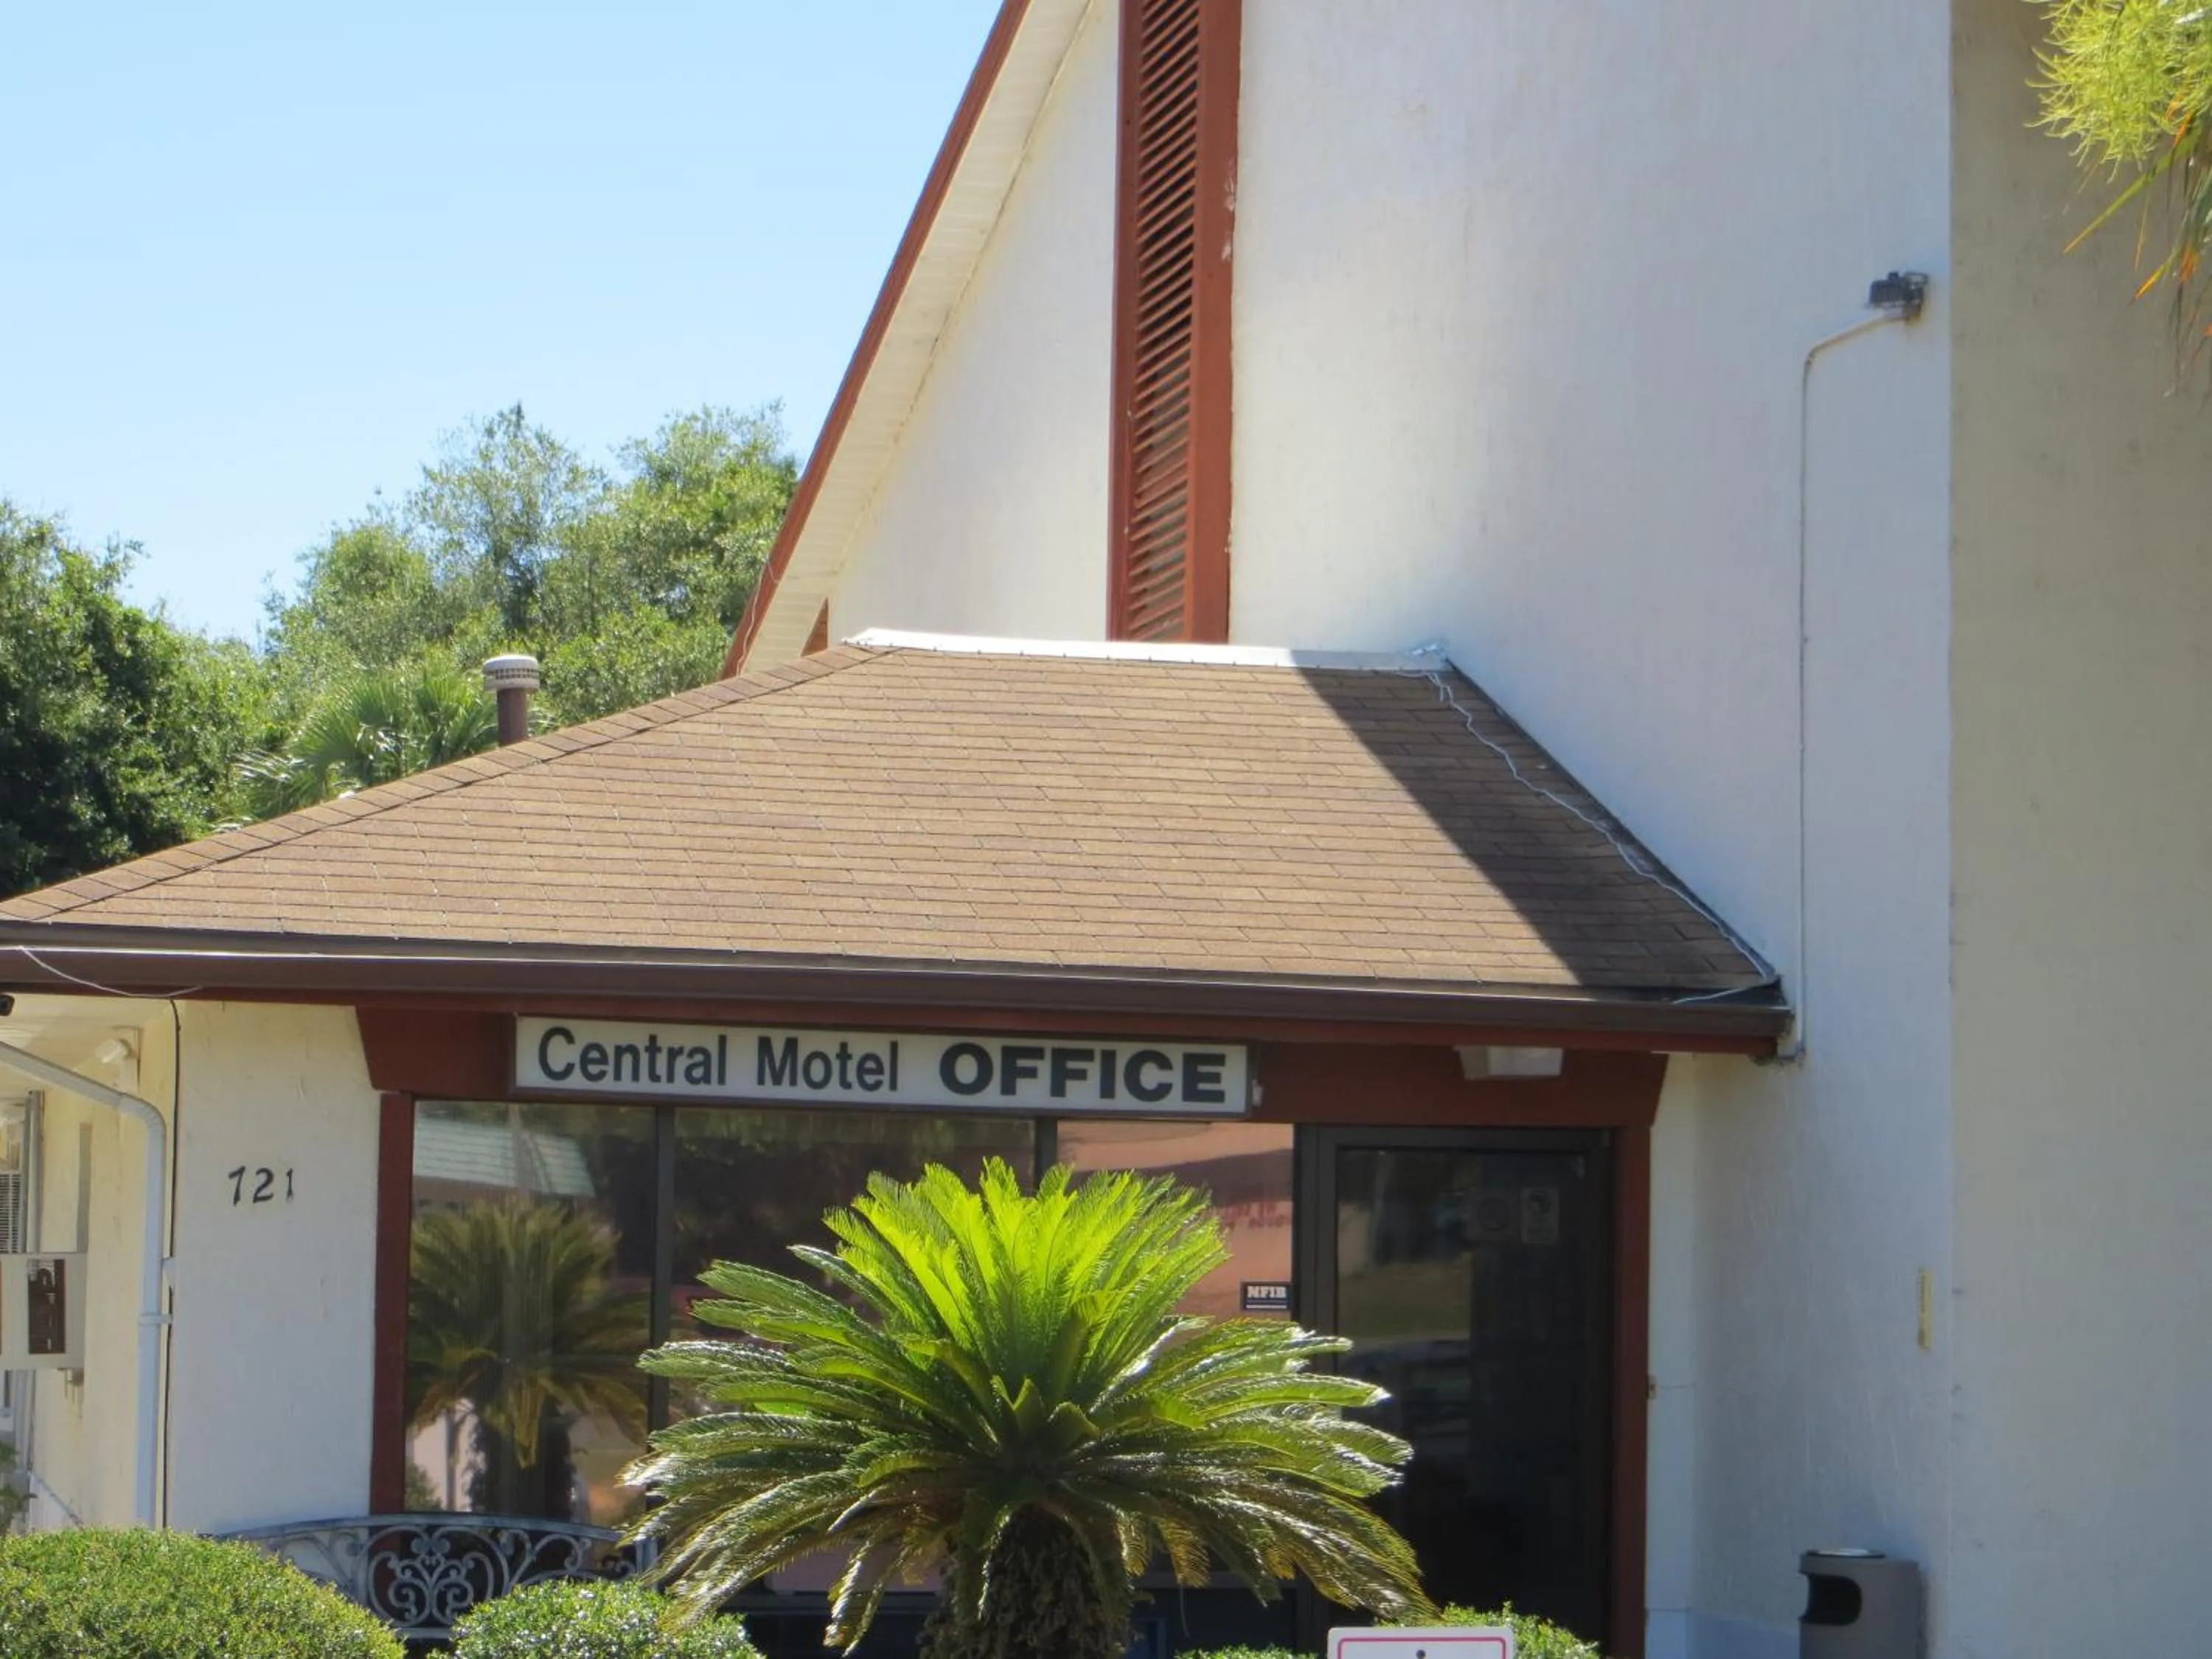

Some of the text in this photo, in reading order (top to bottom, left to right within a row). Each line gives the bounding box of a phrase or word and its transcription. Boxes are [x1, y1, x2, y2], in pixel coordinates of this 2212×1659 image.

[538, 1026, 1226, 1104] Central Motel OFFICE
[227, 1165, 293, 1207] 721
